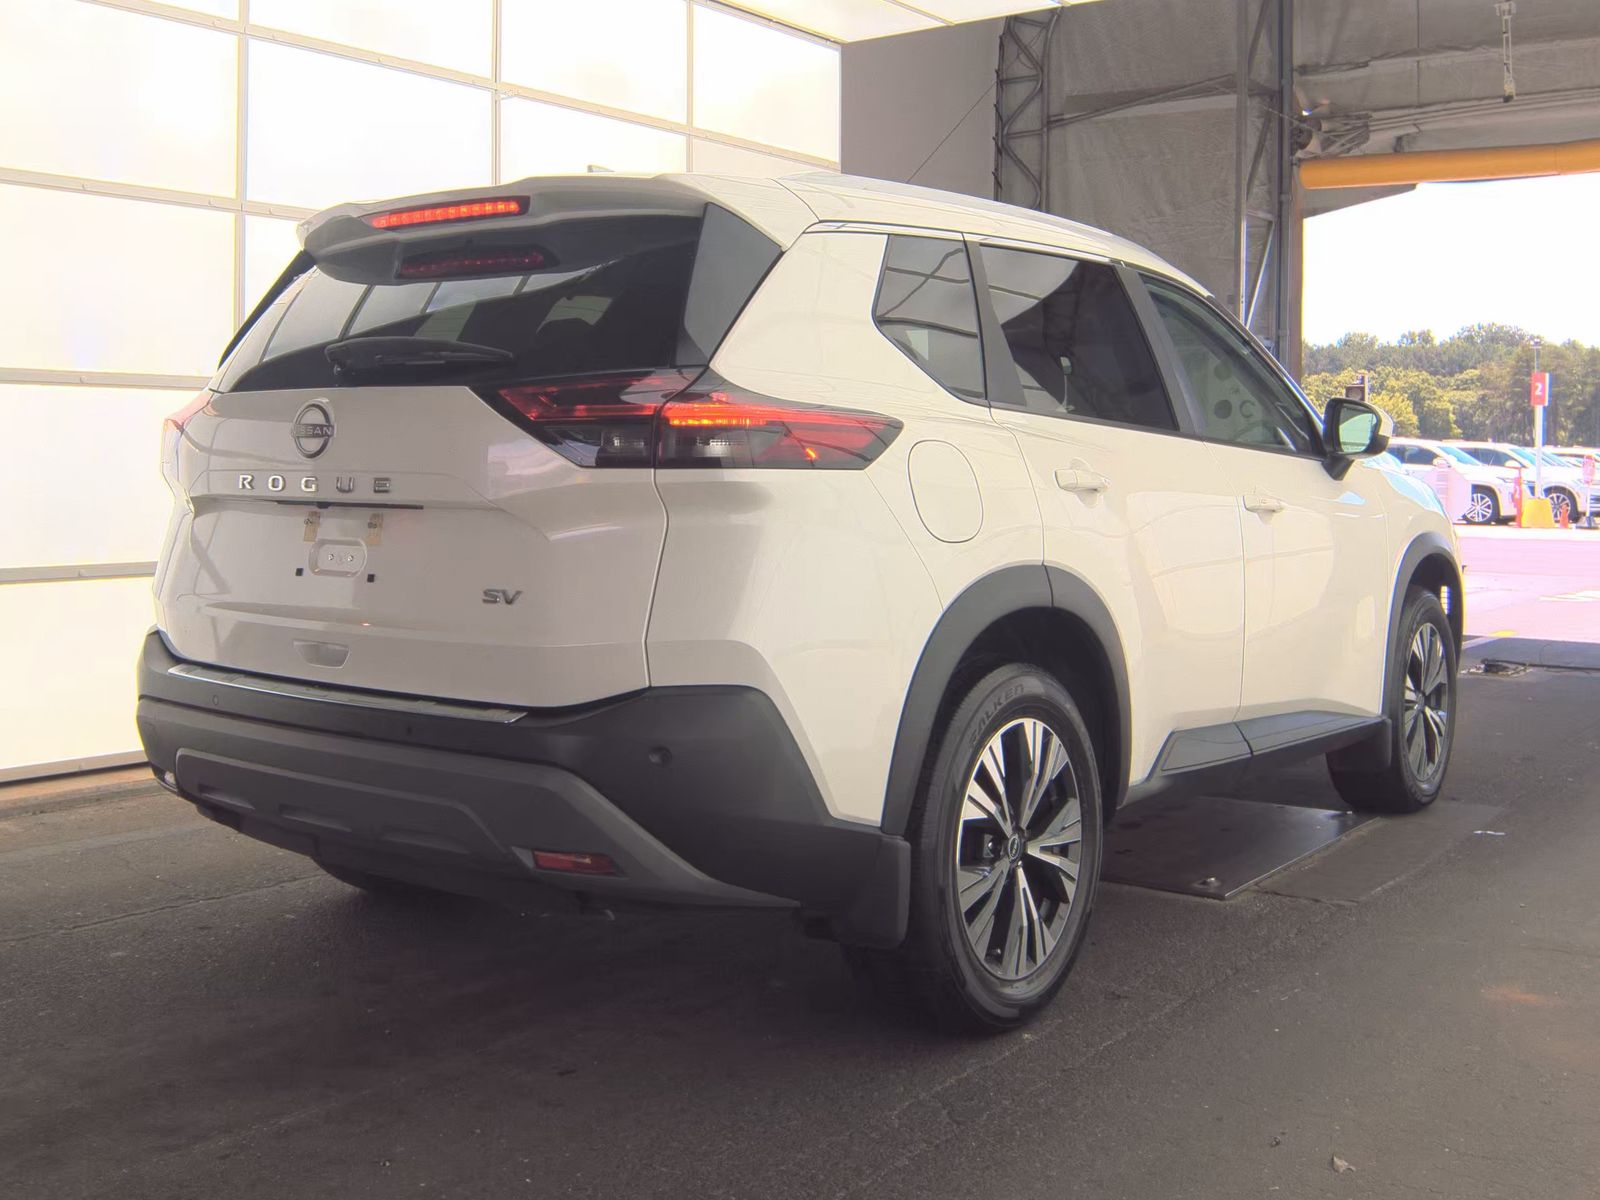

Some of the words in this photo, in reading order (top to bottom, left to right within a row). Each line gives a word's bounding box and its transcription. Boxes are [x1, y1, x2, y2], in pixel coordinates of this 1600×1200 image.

[1535, 382, 1543, 395] 2
[293, 425, 334, 437] SSAN
[238, 474, 391, 494] ROGUE
[482, 588, 523, 605] SV
